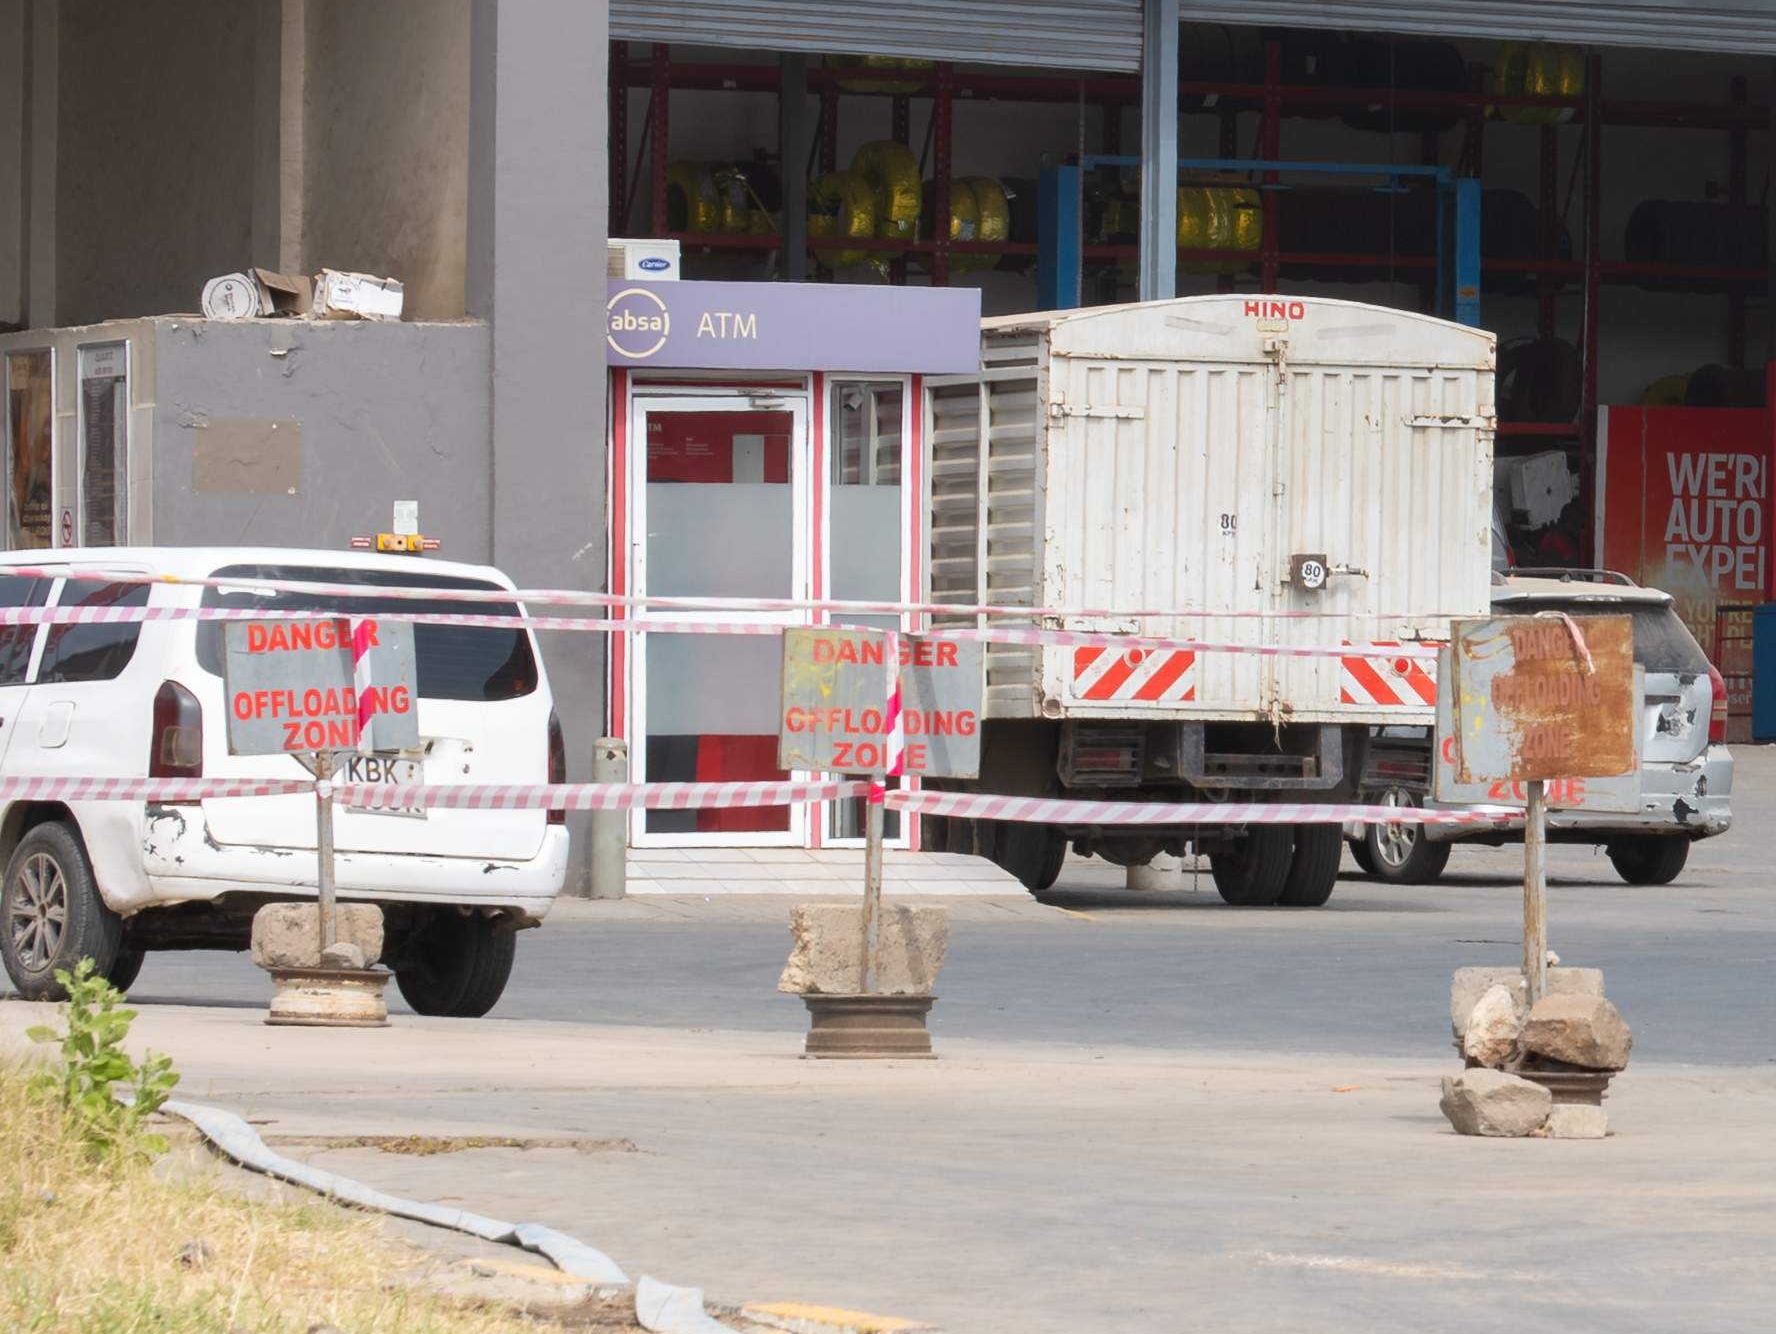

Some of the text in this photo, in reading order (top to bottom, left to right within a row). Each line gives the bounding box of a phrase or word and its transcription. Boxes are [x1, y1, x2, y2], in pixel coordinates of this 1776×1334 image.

[611, 308, 758, 339] absa ATM
[1244, 300, 1306, 320] HINO
[1221, 513, 1237, 530] 80
[1664, 499, 1762, 545] AUTO
[1304, 563, 1321, 579] 80
[233, 685, 410, 721] OFFLOADNG
[785, 707, 977, 737] OFFLODING
[348, 757, 398, 785] KBK
